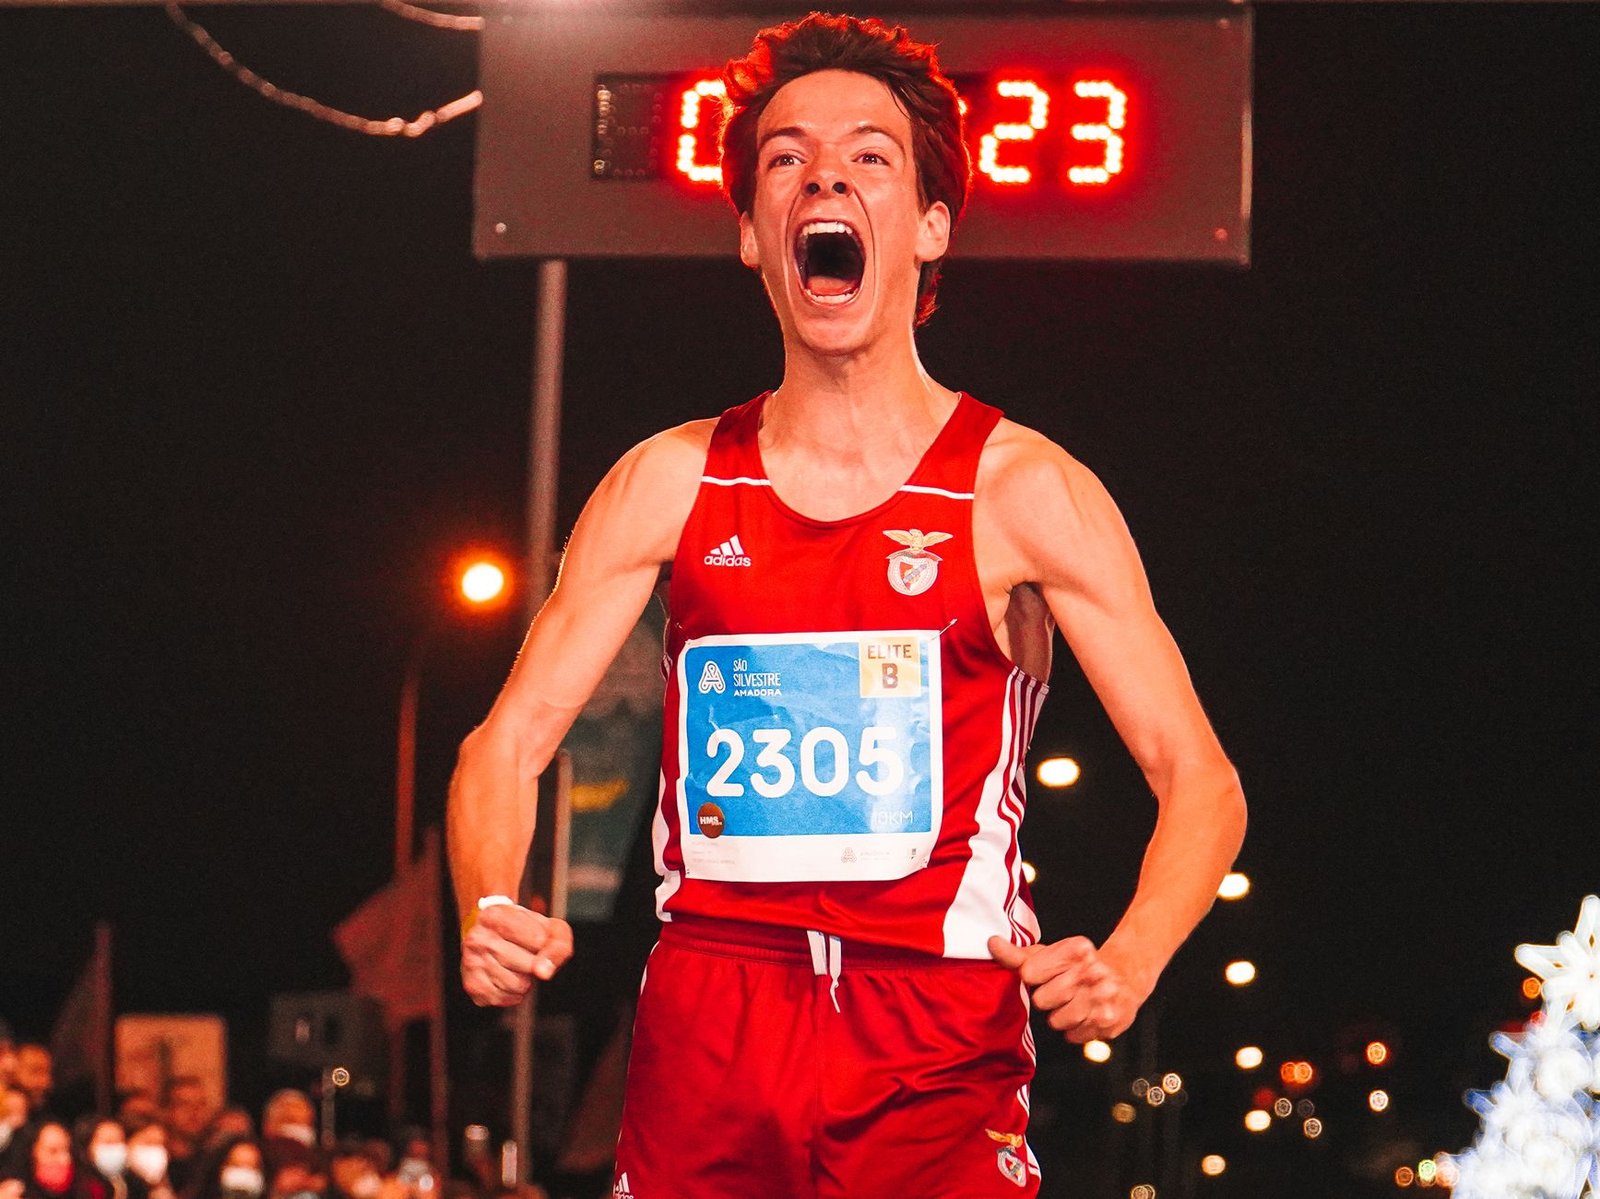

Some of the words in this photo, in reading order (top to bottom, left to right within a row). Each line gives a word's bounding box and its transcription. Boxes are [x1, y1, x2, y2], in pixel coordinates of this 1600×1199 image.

[703, 553, 751, 567] adidas
[867, 644, 913, 660] ELITE
[733, 658, 748, 672] SÃO
[733, 672, 782, 687] SILVESTRE
[881, 662, 899, 689] B
[733, 688, 783, 697] AMADORA
[706, 726, 905, 798] 2305
[699, 815, 720, 826] HMS
